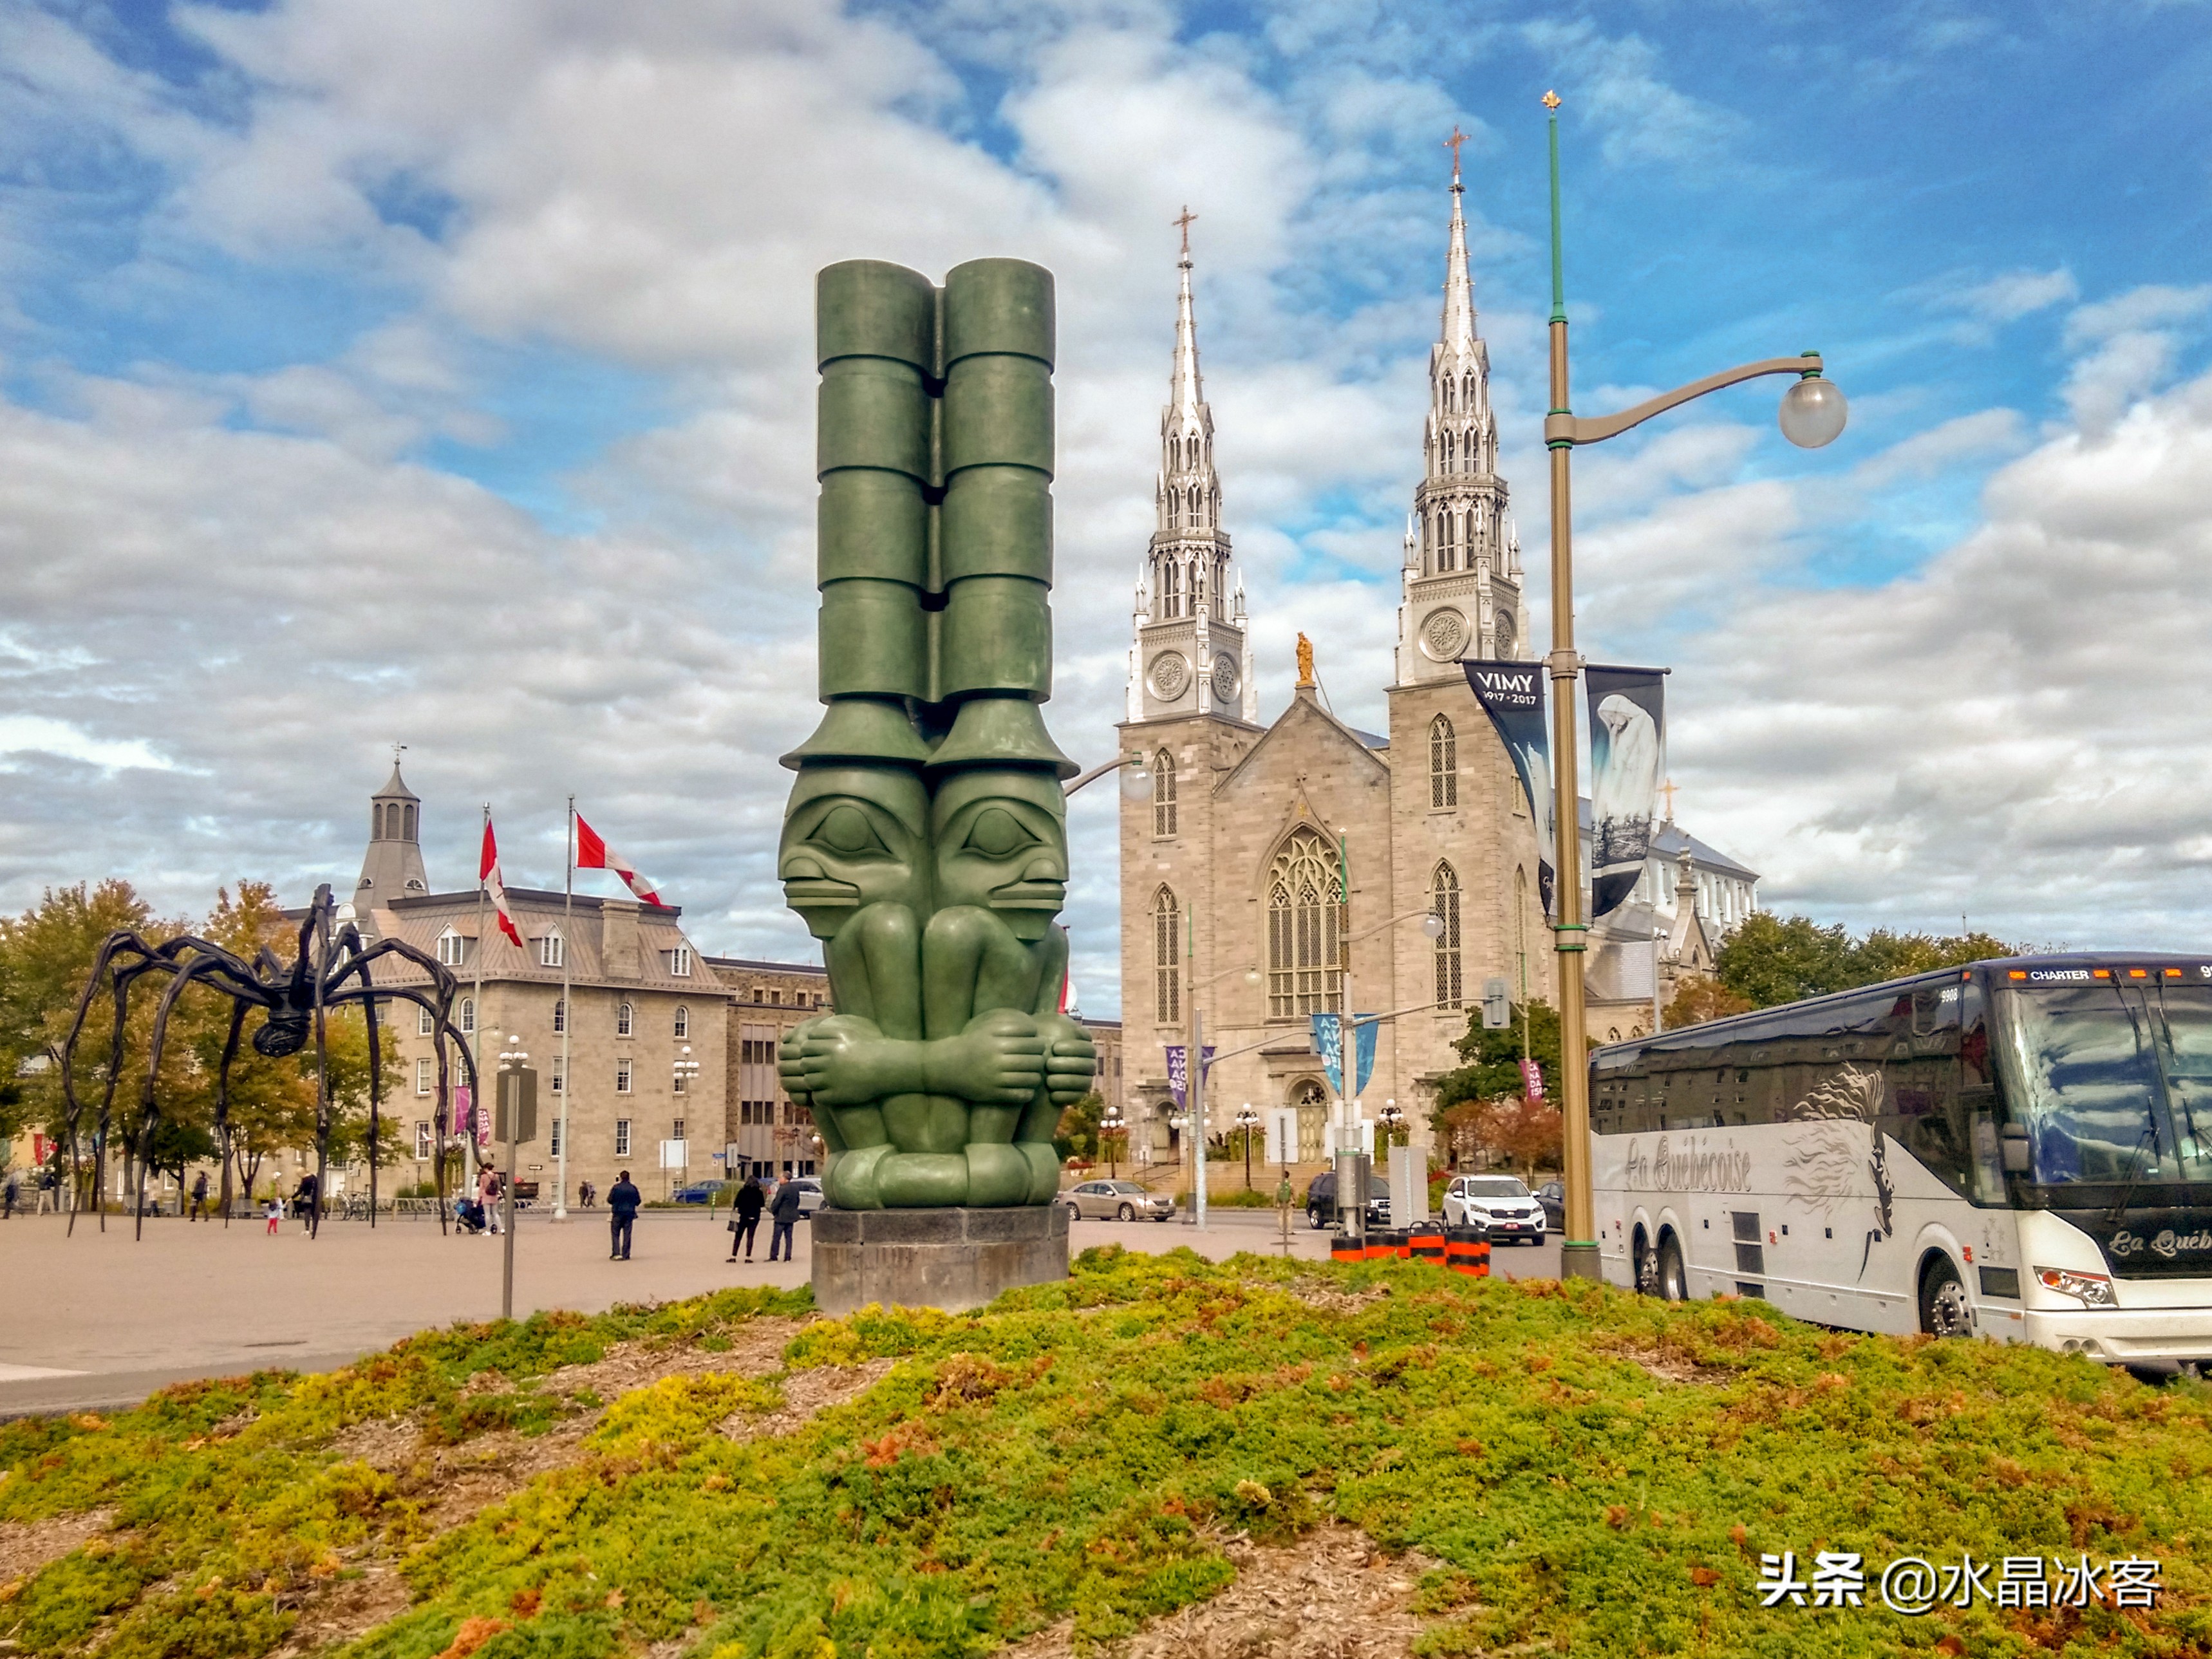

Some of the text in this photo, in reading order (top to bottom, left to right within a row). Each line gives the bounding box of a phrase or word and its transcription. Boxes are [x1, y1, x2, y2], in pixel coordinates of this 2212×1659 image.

[1476, 672, 1533, 692] VIMY
[2030, 970, 2090, 980] CHARTER
[1942, 988, 1958, 1002] 9908
[2109, 1230, 2144, 1257] La
